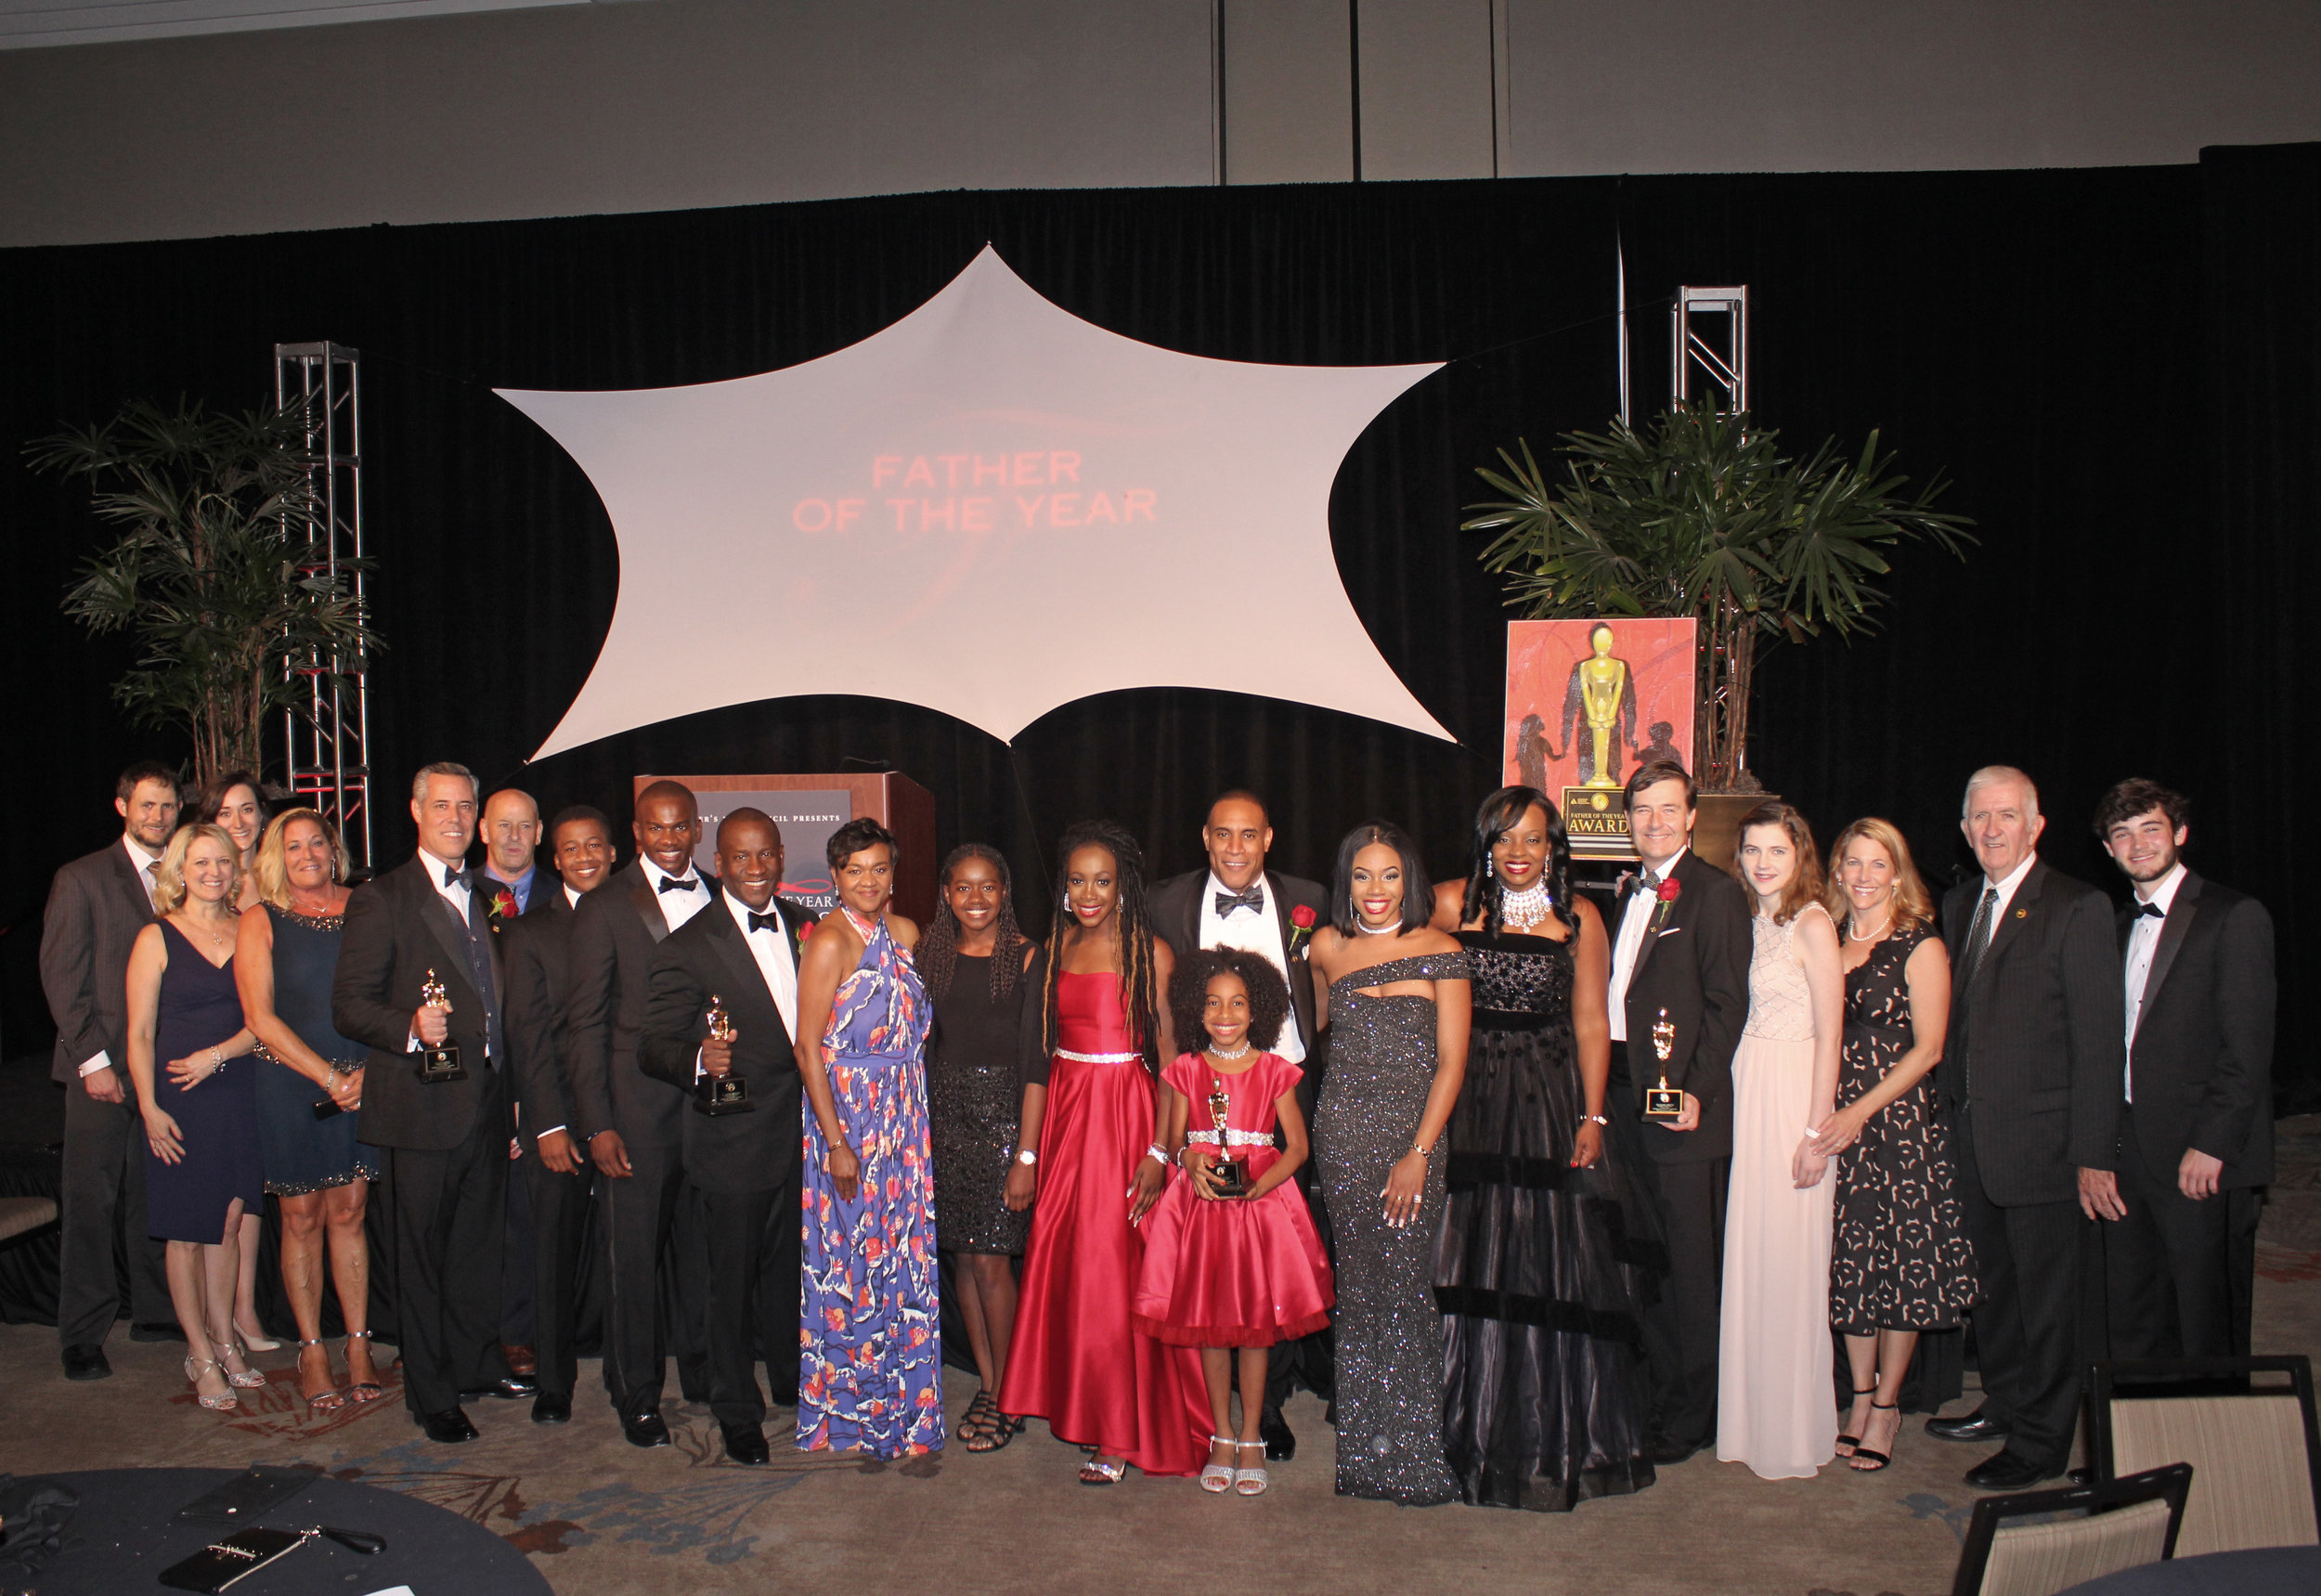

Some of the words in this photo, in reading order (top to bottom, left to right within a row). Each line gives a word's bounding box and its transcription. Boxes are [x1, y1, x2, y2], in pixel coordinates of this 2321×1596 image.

[873, 450, 1083, 489] FATHER
[792, 499, 866, 533] OF
[886, 497, 993, 532] THE
[1017, 489, 1158, 529] YEAR
[1568, 819, 1629, 833] AWARD
[796, 896, 834, 907] YEAR
